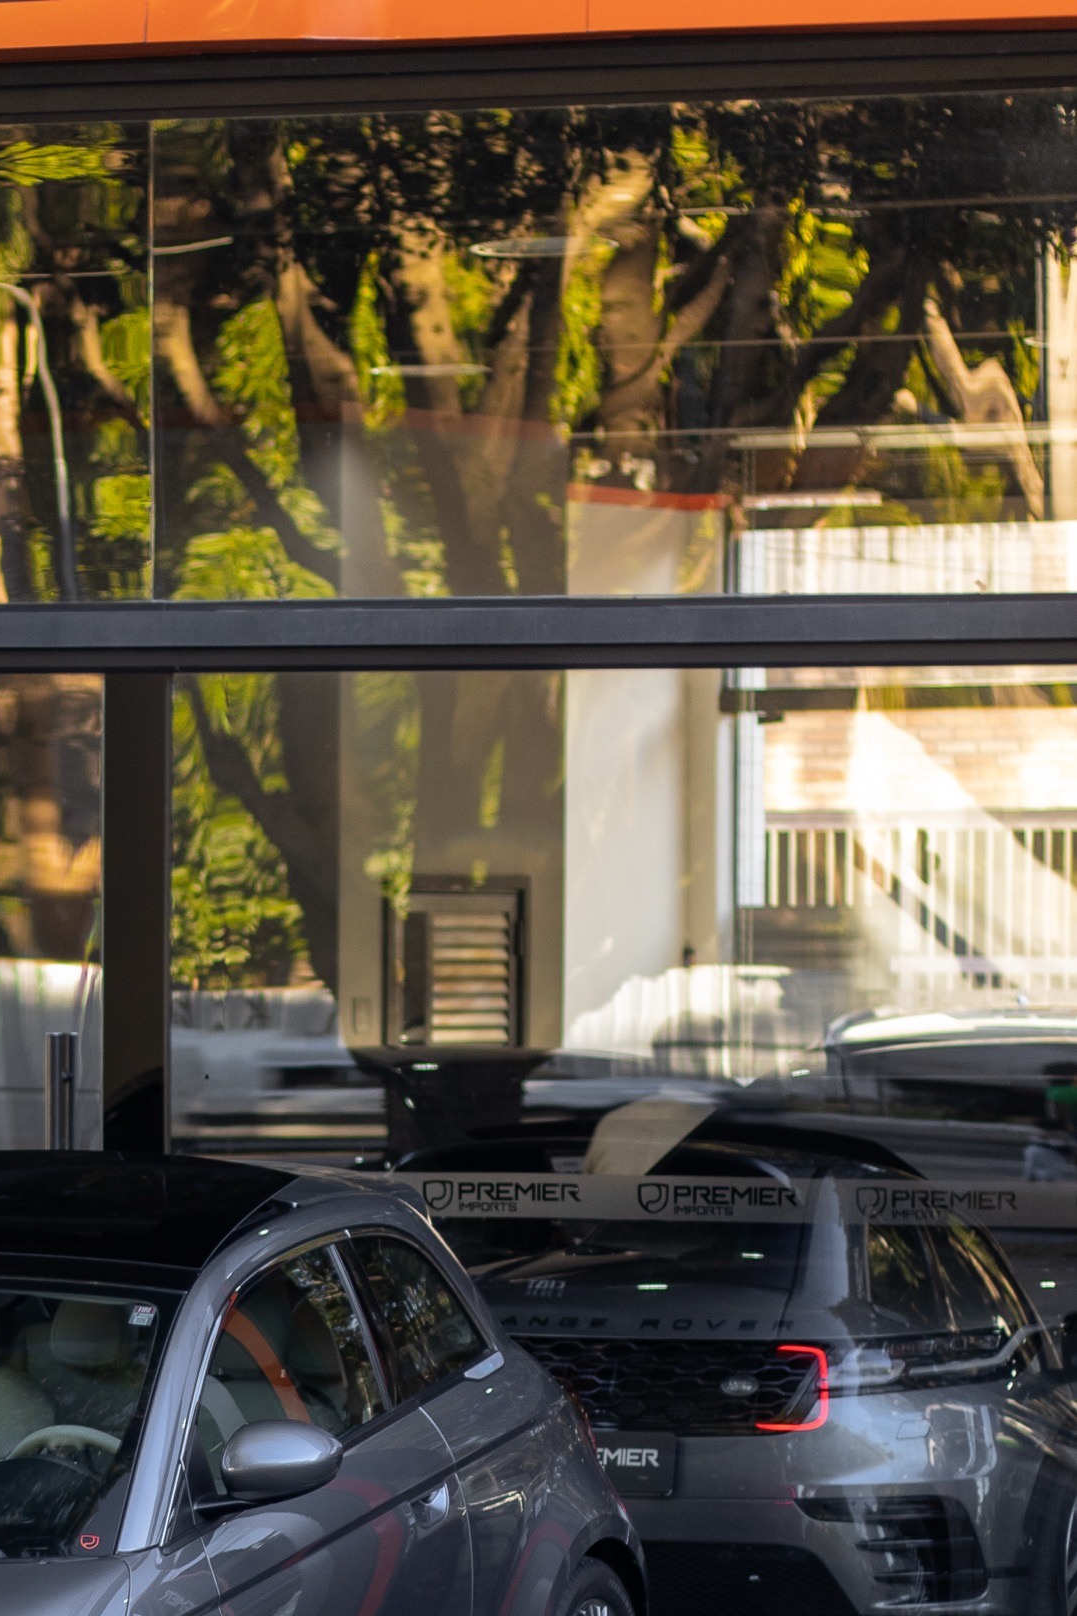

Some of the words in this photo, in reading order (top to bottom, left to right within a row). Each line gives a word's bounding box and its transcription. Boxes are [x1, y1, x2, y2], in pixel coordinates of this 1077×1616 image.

[457, 1181, 581, 1202] PREMIER
[672, 1185, 798, 1207] PREMIER
[891, 1189, 1018, 1211] PREMIER
[458, 1202, 518, 1212] IMPORTS
[673, 1206, 734, 1216] IMPORTS
[500, 1314, 609, 1330] ANGE
[639, 1317, 795, 1332] ROVER
